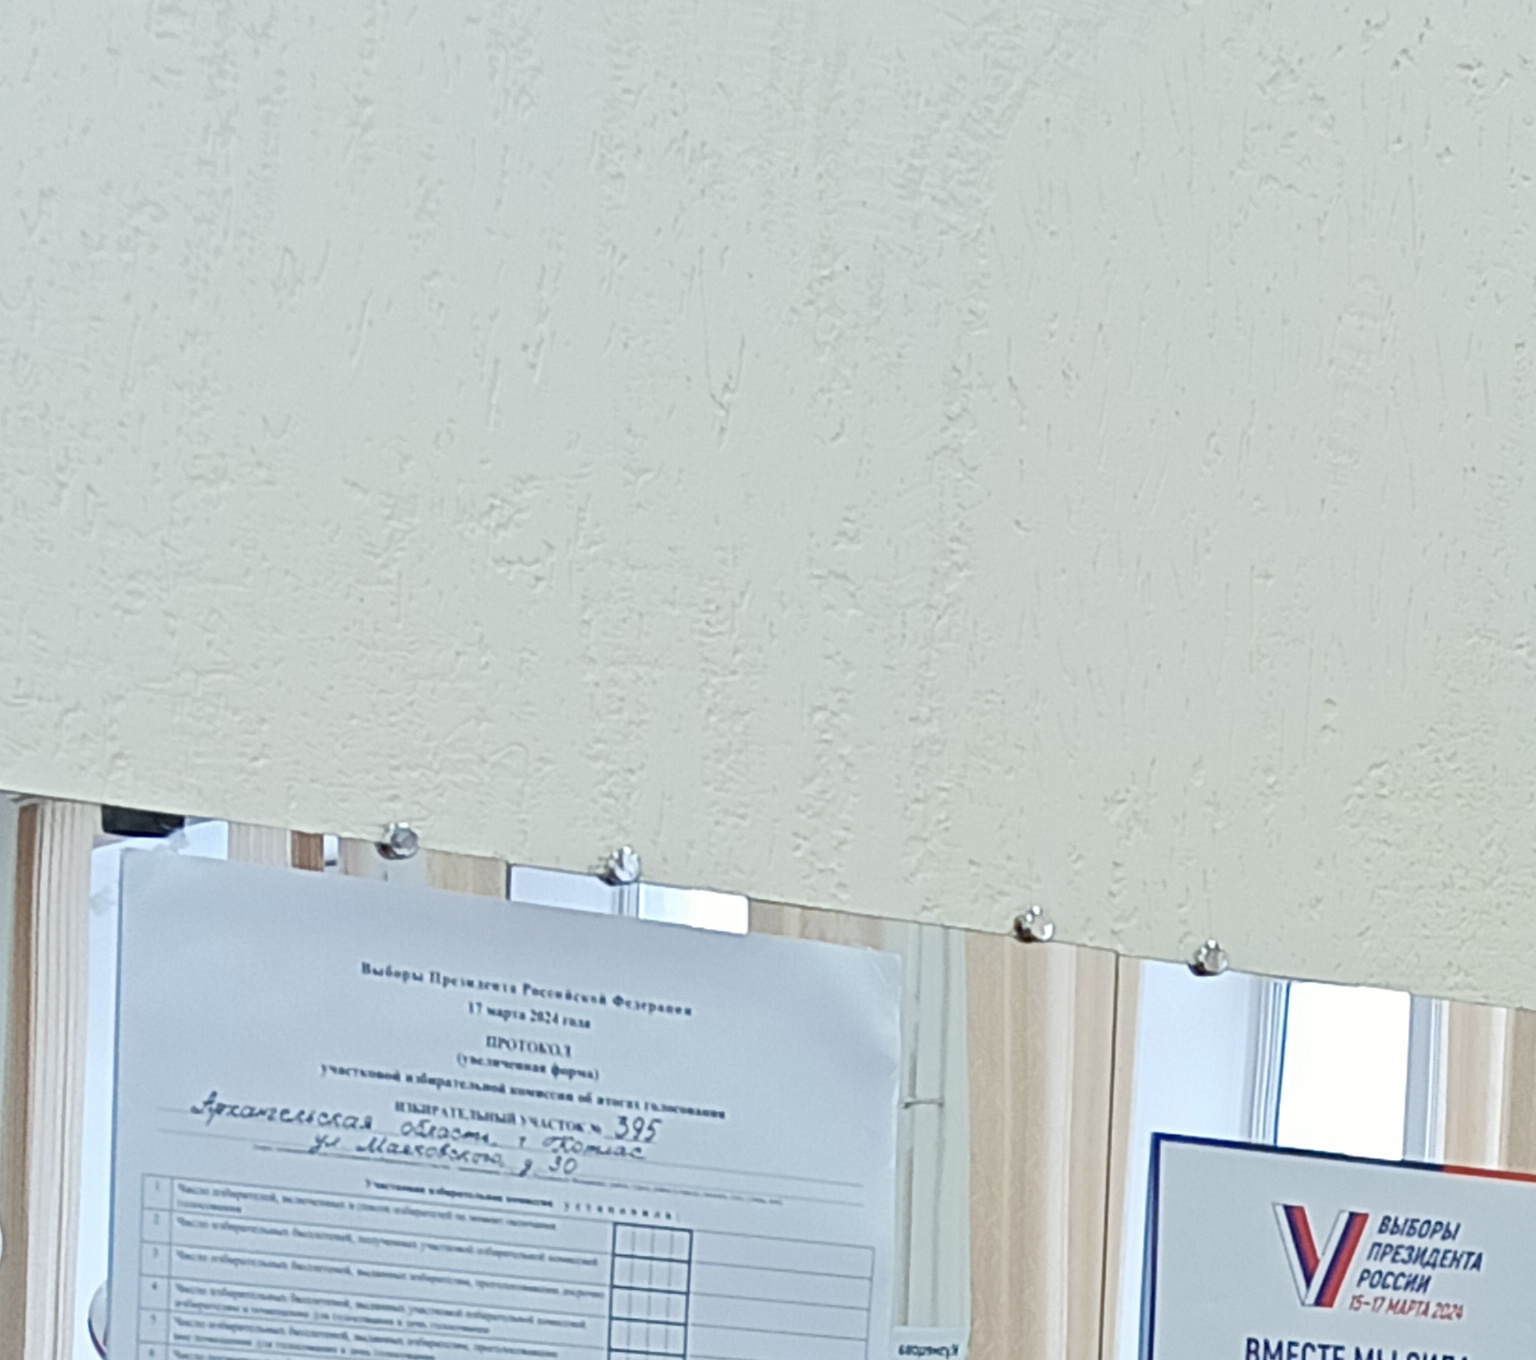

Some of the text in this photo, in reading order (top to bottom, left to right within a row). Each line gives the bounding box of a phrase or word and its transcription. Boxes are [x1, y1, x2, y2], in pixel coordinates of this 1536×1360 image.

[613, 1113, 663, 1145] 395
[547, 1154, 579, 1176] 30
[1377, 1214, 1461, 1241] ВЫБОРЫ
[1366, 1241, 1483, 1272] ПРЕЗИДЕНТА
[1356, 1268, 1431, 1294] РОССИИ
[1386, 1297, 1430, 1318] МАРТА
[1431, 1301, 1464, 1320] 2024
